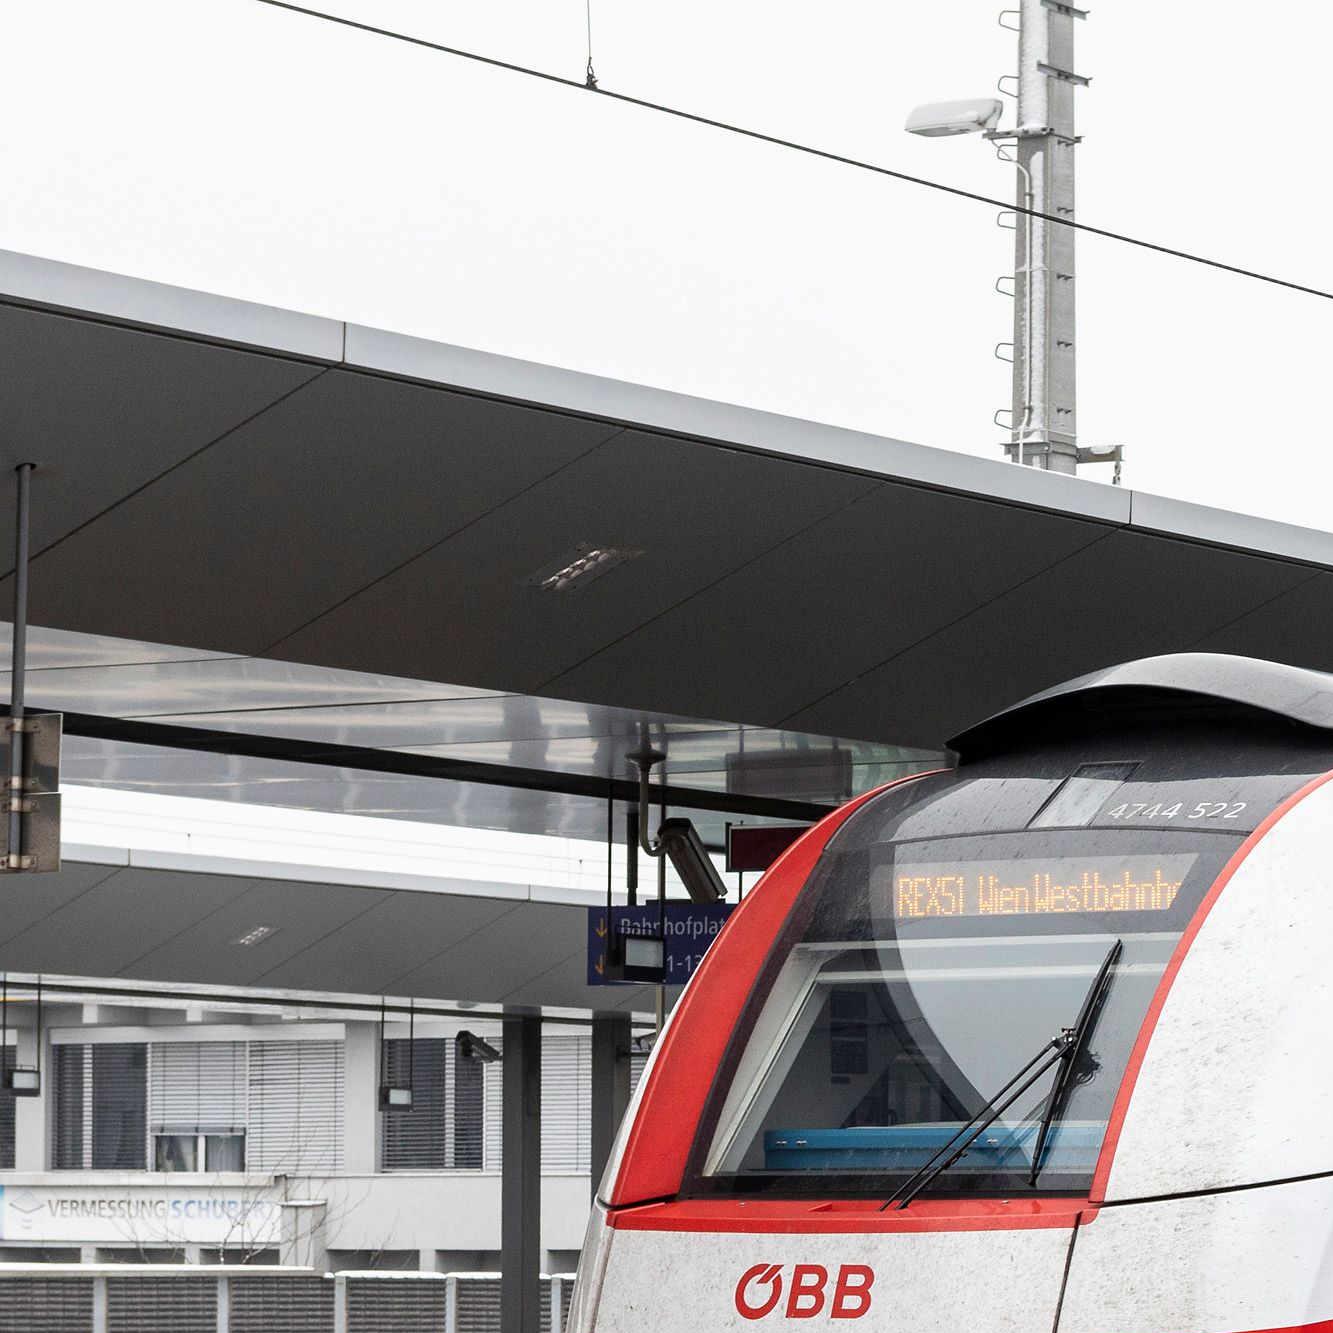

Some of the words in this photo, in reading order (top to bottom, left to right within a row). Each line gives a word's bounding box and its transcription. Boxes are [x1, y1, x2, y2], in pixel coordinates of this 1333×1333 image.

[1109, 802, 1183, 819] 4744
[1188, 802, 1246, 819] 522
[899, 876, 963, 916] REX51
[979, 875, 1029, 913] Wien
[47, 1199, 166, 1219] VERMESSUNG
[734, 1263, 875, 1321] ÖBB
